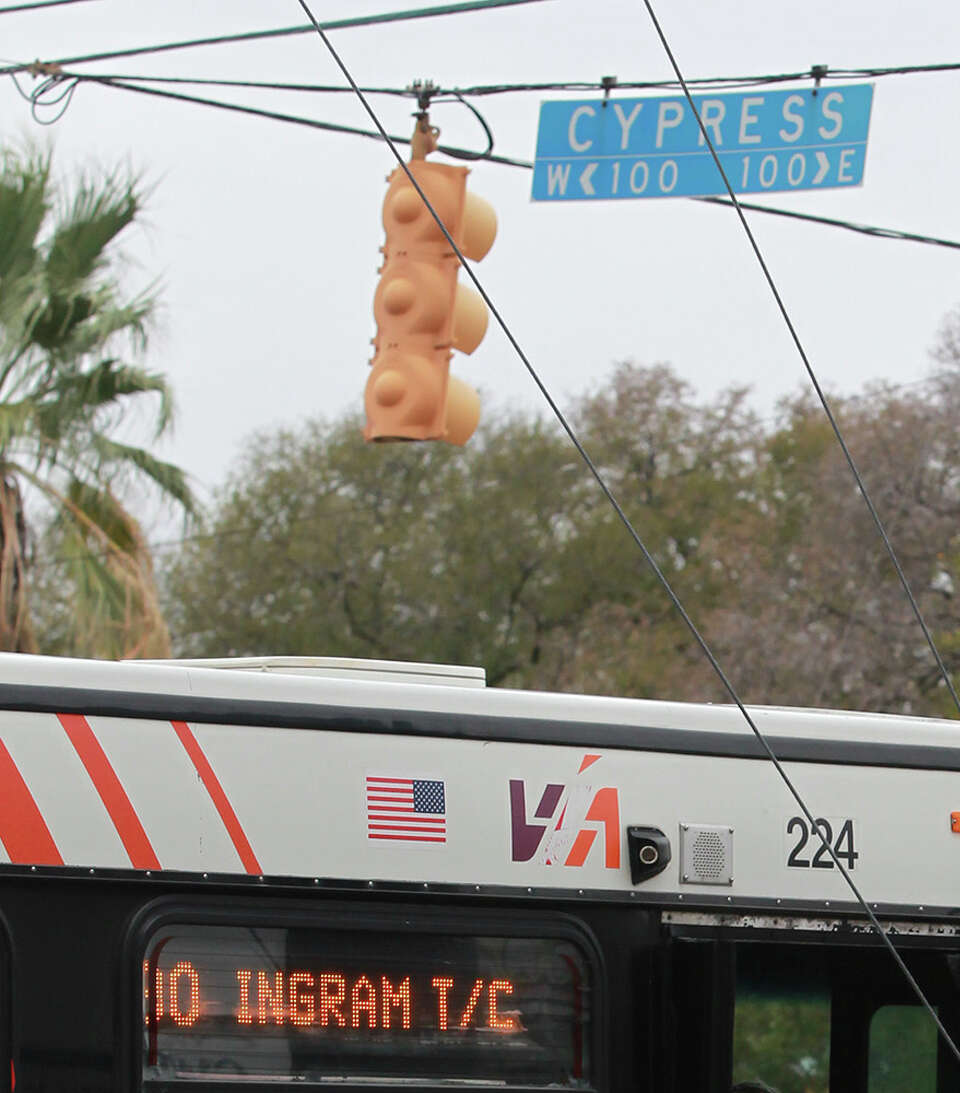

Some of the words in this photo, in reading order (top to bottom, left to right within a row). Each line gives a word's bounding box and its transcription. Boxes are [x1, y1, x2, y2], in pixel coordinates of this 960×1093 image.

[568, 92, 844, 151] CYPRESS
[547, 164, 570, 195] W
[612, 160, 678, 194] 100
[742, 153, 806, 188] 100
[838, 149, 856, 182] E
[509, 754, 620, 869] VA
[786, 816, 858, 870] 224
[234, 969, 411, 1030] INGRAM
[432, 977, 514, 1031] T/C
